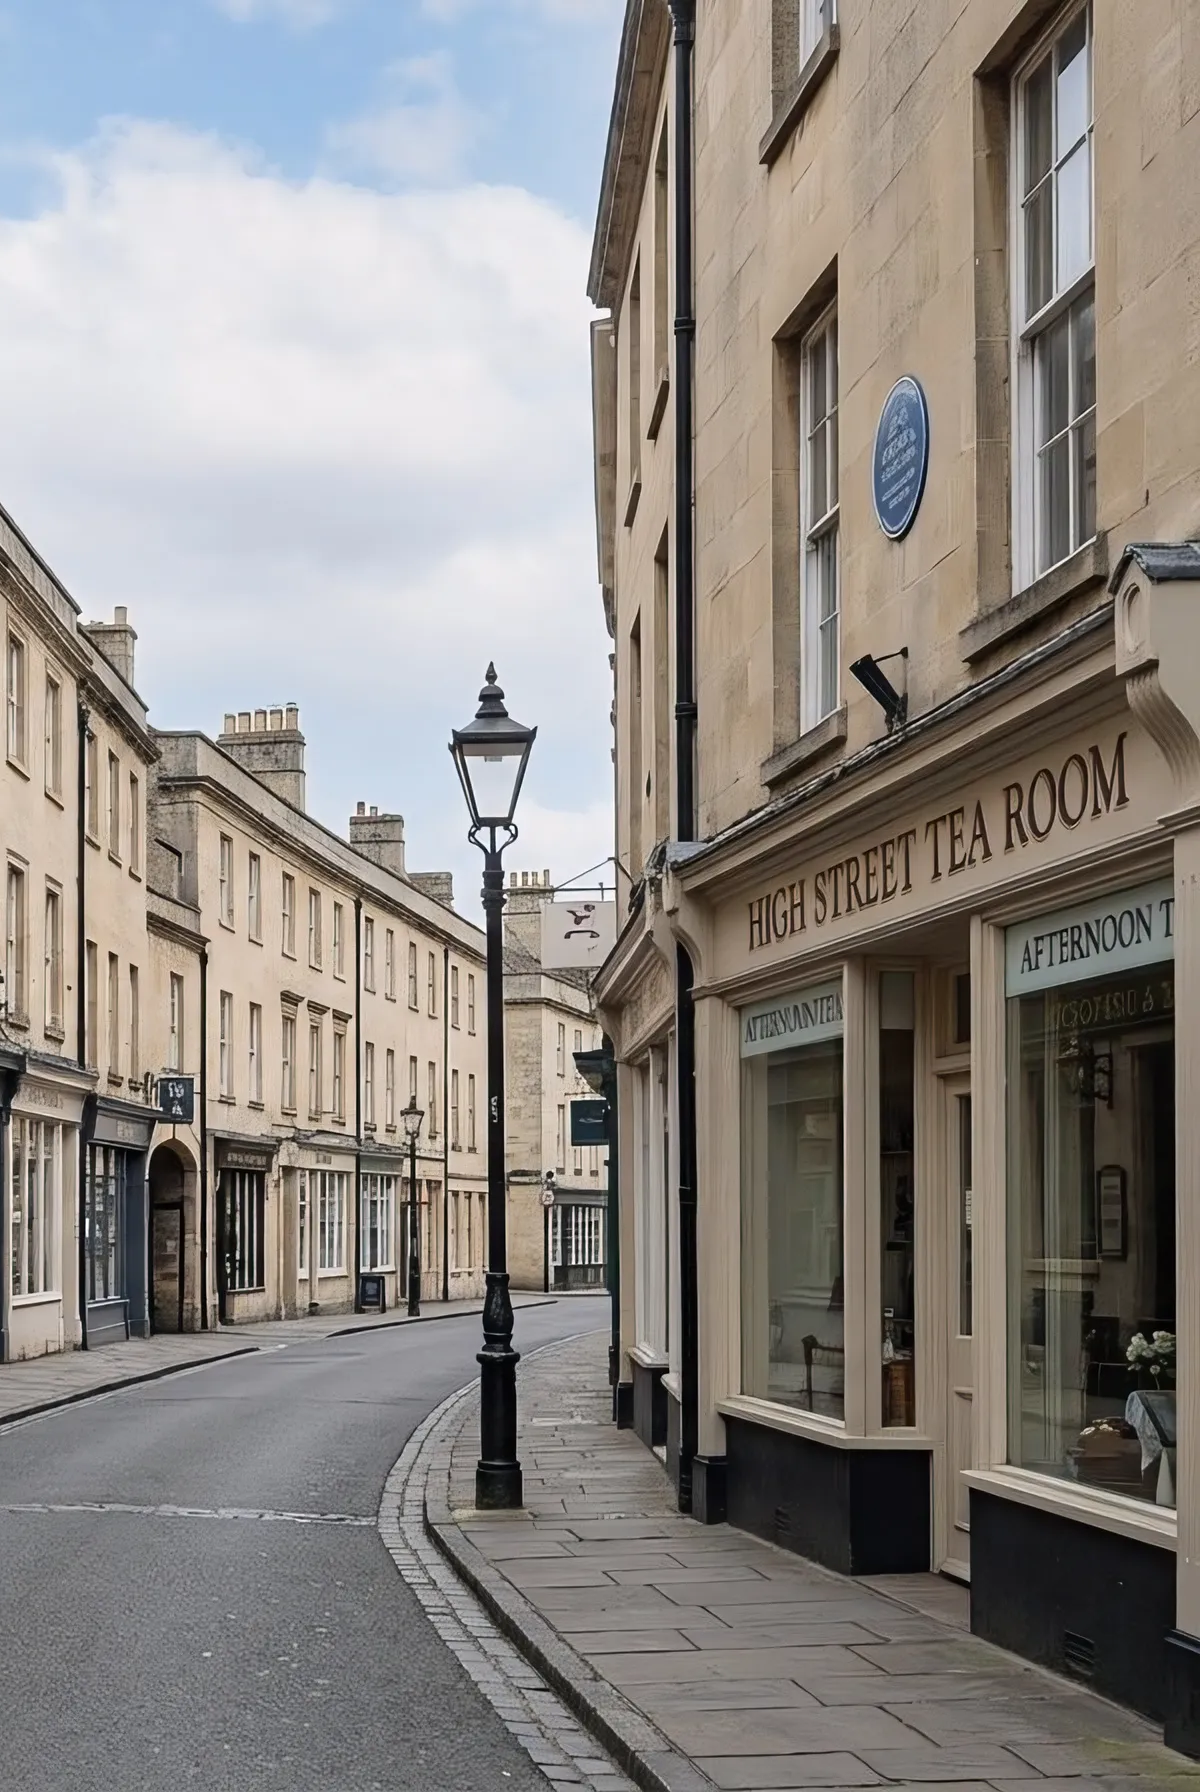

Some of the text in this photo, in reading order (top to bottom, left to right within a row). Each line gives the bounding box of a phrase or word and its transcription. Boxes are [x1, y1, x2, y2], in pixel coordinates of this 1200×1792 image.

[747, 731, 1130, 951] HIGH STREET TEA ROOM
[1020, 903, 1153, 975] AFTERNOON
